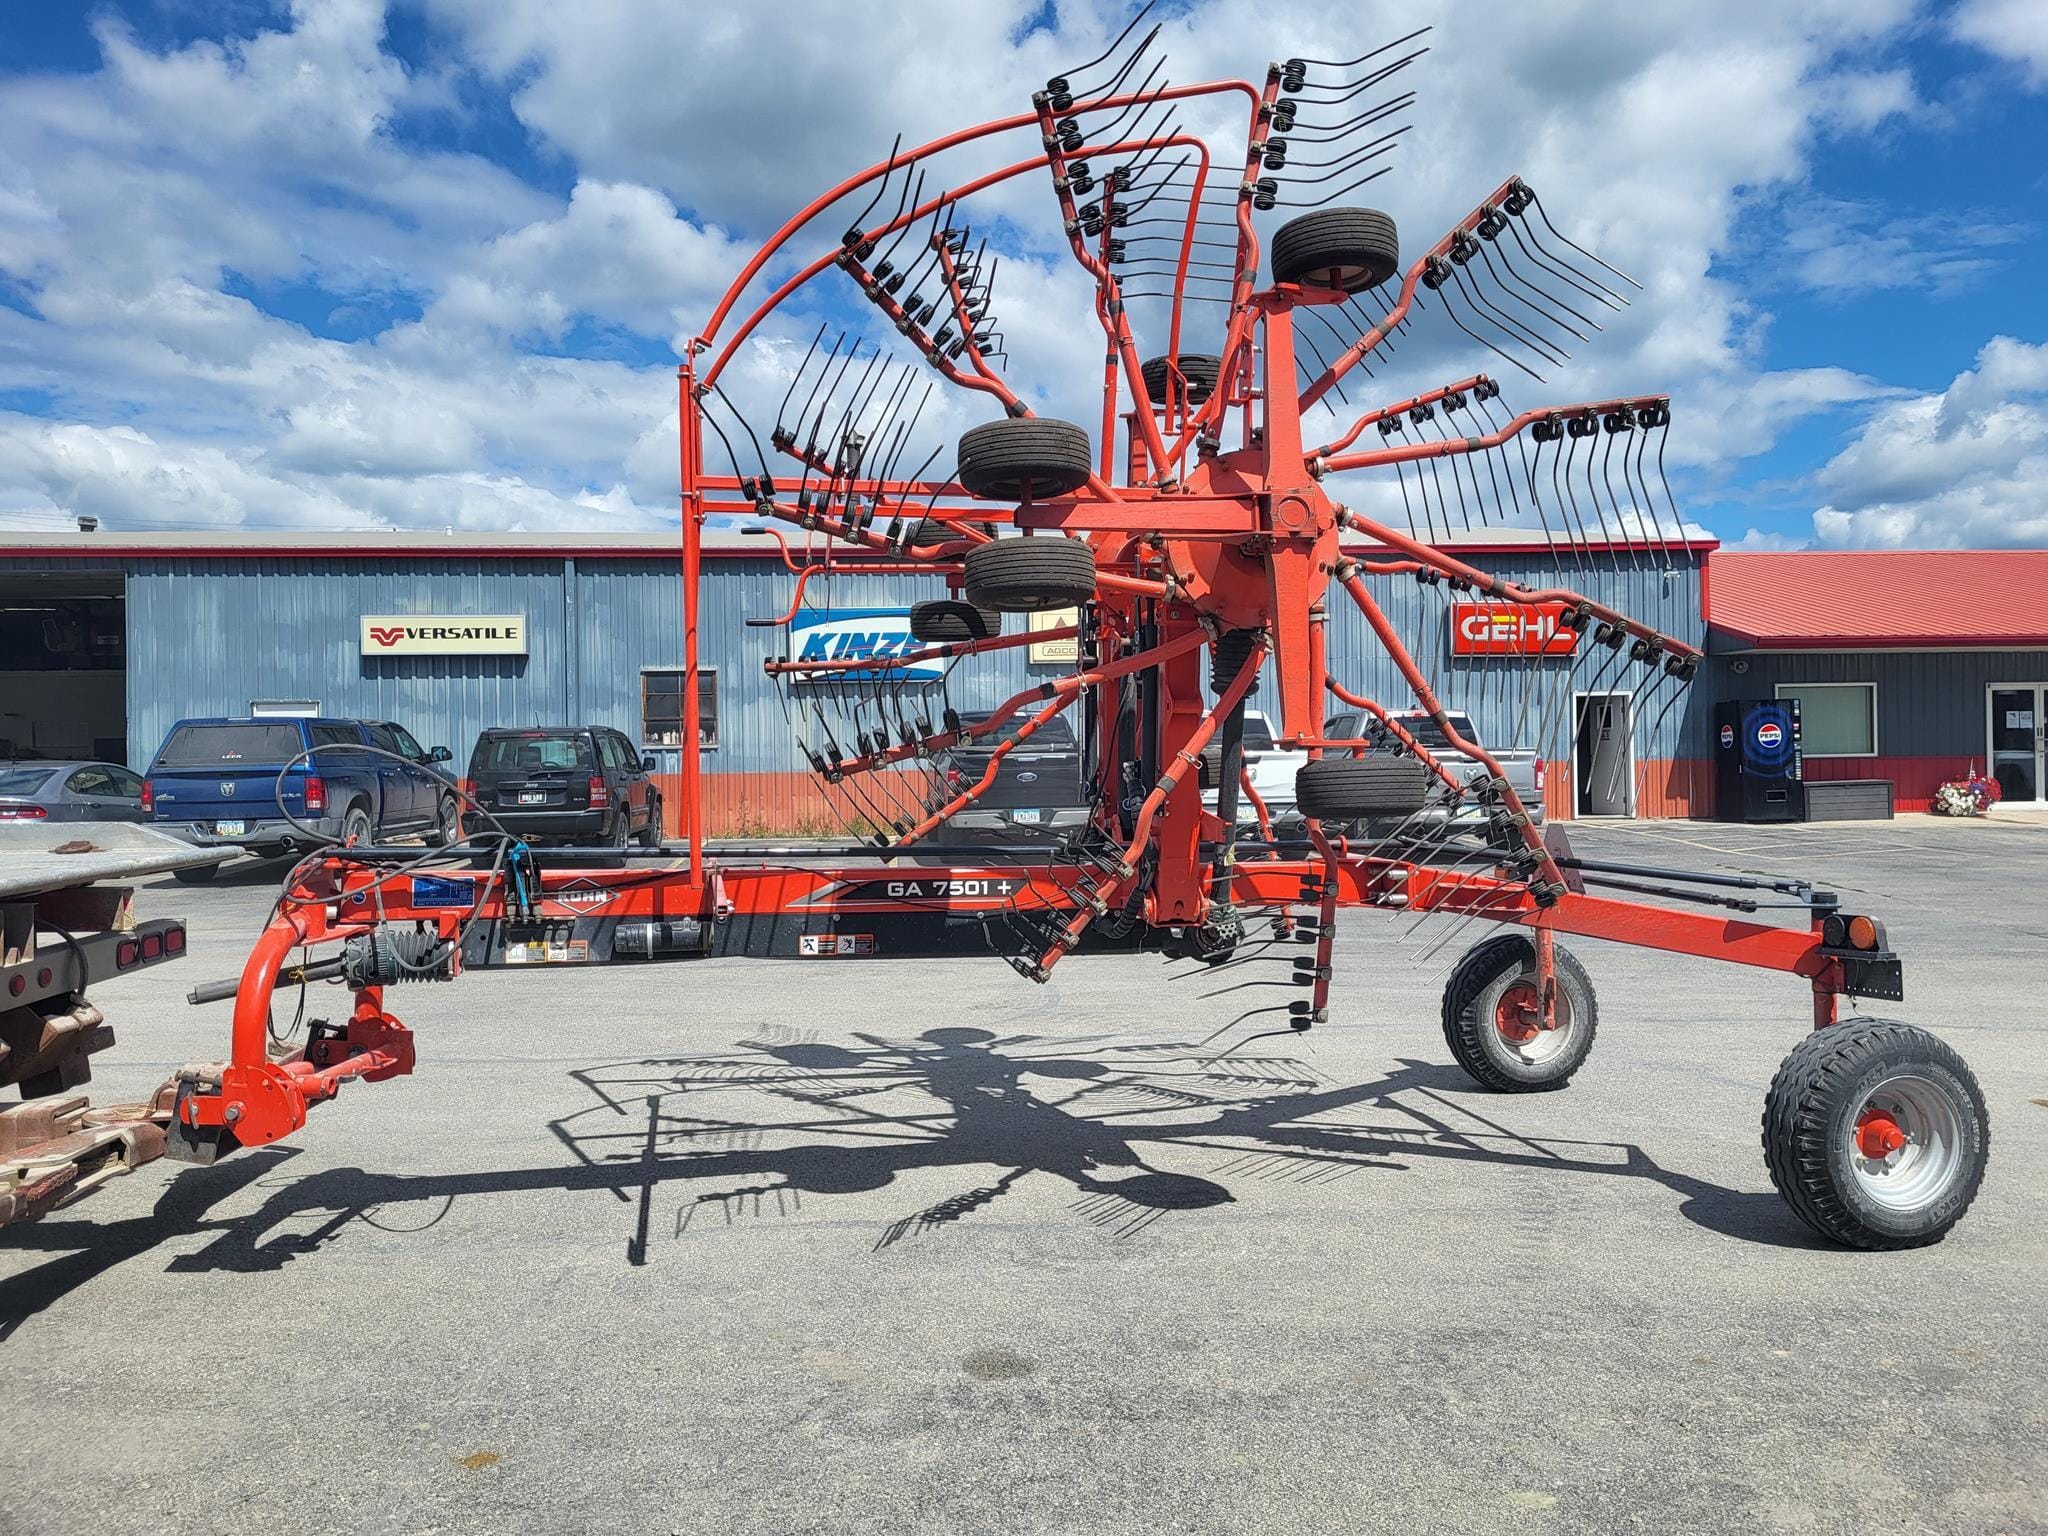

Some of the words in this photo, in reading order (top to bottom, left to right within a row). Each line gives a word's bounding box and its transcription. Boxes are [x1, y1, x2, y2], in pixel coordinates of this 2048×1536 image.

[406, 628, 518, 639] VERSATILE
[1461, 616, 1572, 641] GEHL
[557, 889, 607, 902] KUHN
[887, 882, 923, 896] GA
[932, 880, 988, 895] 7501
[997, 880, 1011, 895] +
[1933, 1193, 1961, 1222] BKT
